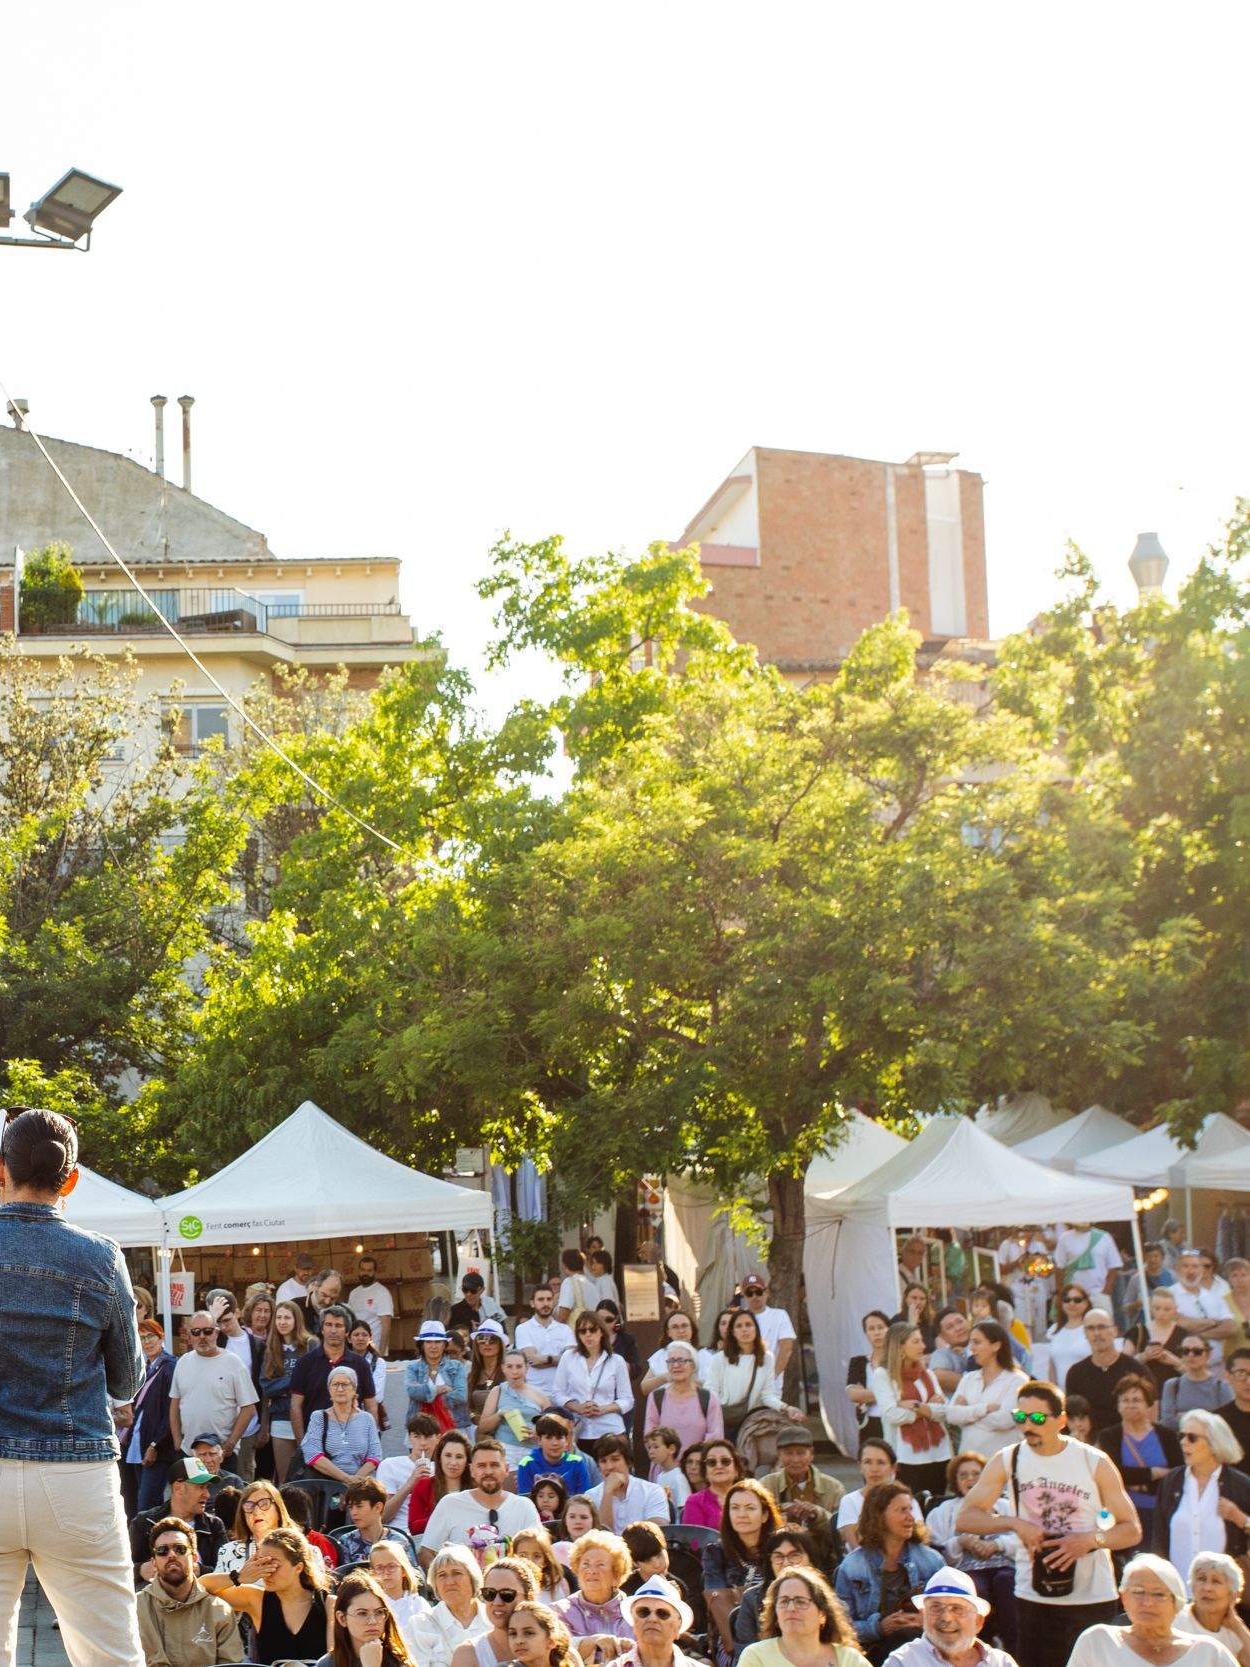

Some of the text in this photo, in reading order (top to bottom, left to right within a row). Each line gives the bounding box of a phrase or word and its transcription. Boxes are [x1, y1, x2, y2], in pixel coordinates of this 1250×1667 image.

[223, 1220, 251, 1230] comerç
[252, 1219, 263, 1227] fas
[263, 1218, 286, 1227] Ciutat
[1037, 1476, 1091, 1500] Angeles
